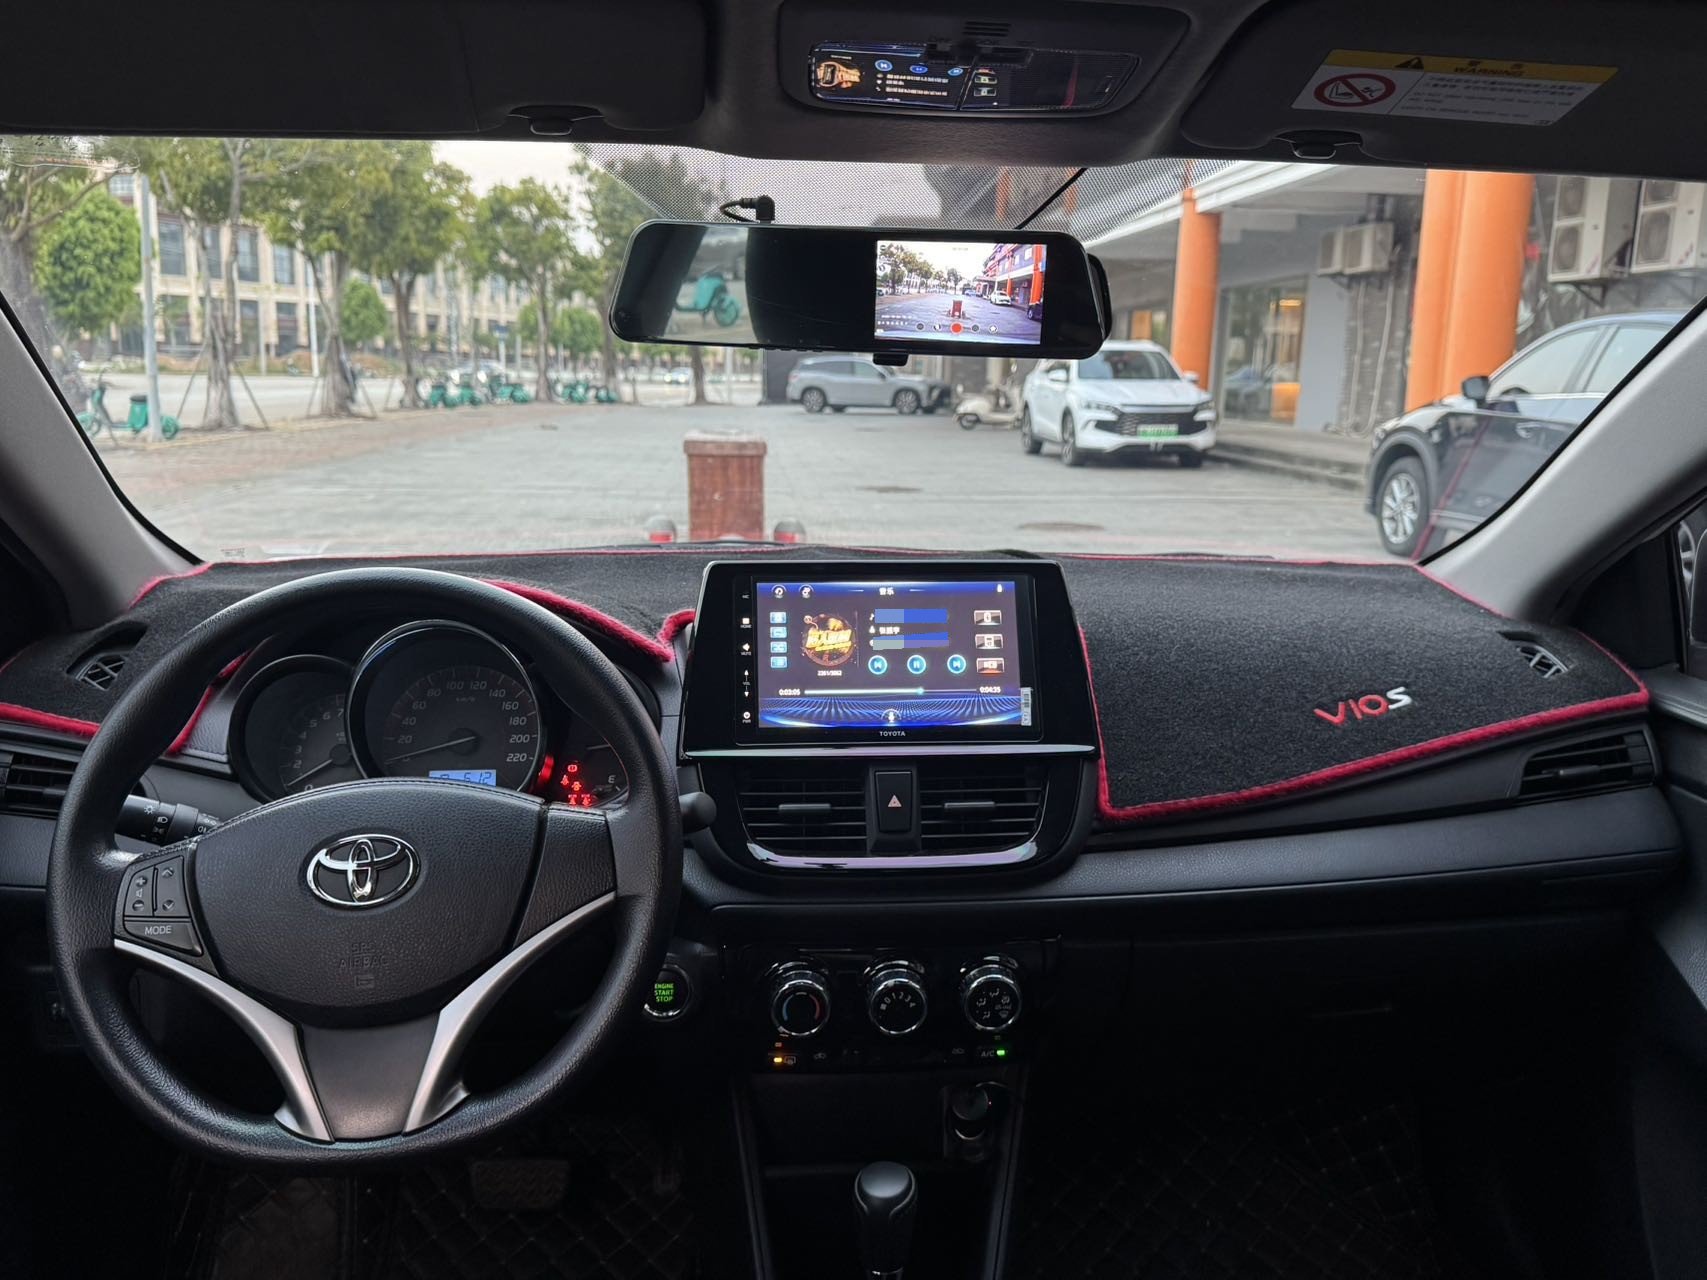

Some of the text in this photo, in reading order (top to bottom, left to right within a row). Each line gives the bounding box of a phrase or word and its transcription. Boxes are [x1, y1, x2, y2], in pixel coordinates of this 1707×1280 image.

[446, 681, 464, 690] 100
[470, 681, 487, 690] 120
[489, 689, 506, 698] 140
[412, 702, 427, 710] 60
[502, 702, 519, 710] 160
[1313, 686, 1412, 724] VIOS
[323, 712, 331, 720] 6
[337, 708, 344, 718] 7
[309, 719, 317, 728] 5
[402, 717, 416, 726] 40
[509, 717, 527, 726] 180
[397, 735, 412, 744] 20
[509, 735, 530, 744] 200
[506, 753, 528, 762] 220
[293, 760, 302, 769] 2
[608, 775, 616, 784] E
[145, 926, 172, 935] MODE
[352, 942, 376, 953] SRS
[338, 956, 390, 968] AIRBAG
